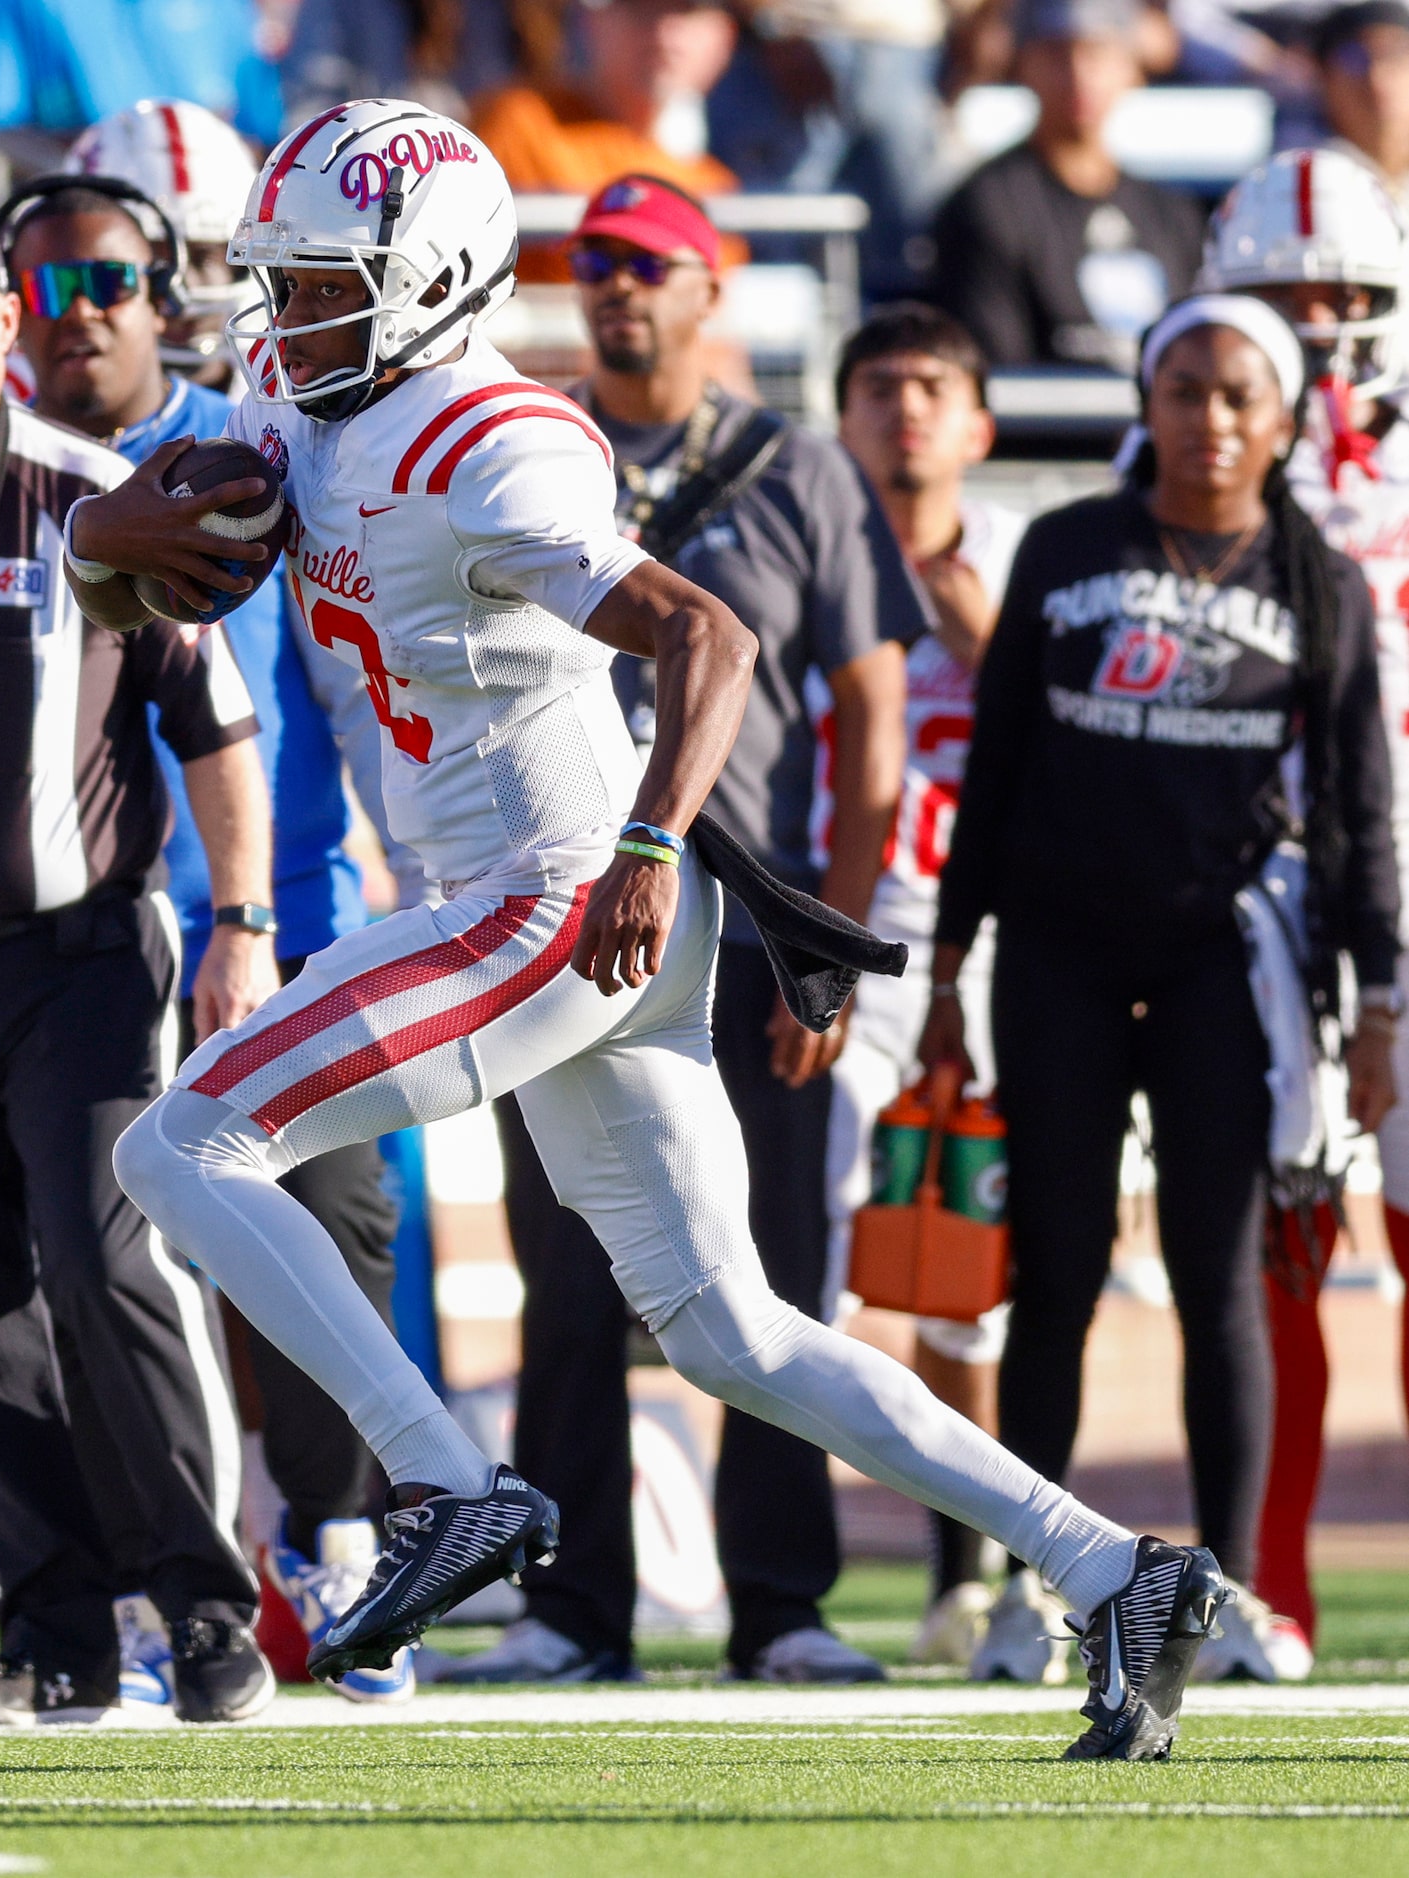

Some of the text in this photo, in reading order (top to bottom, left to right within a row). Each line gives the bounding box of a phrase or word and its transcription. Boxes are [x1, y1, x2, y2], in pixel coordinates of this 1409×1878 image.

[339, 128, 478, 212] D'Ville
[1145, 702, 1286, 749] MEDICINE
[496, 1476, 528, 1492] NIKE
